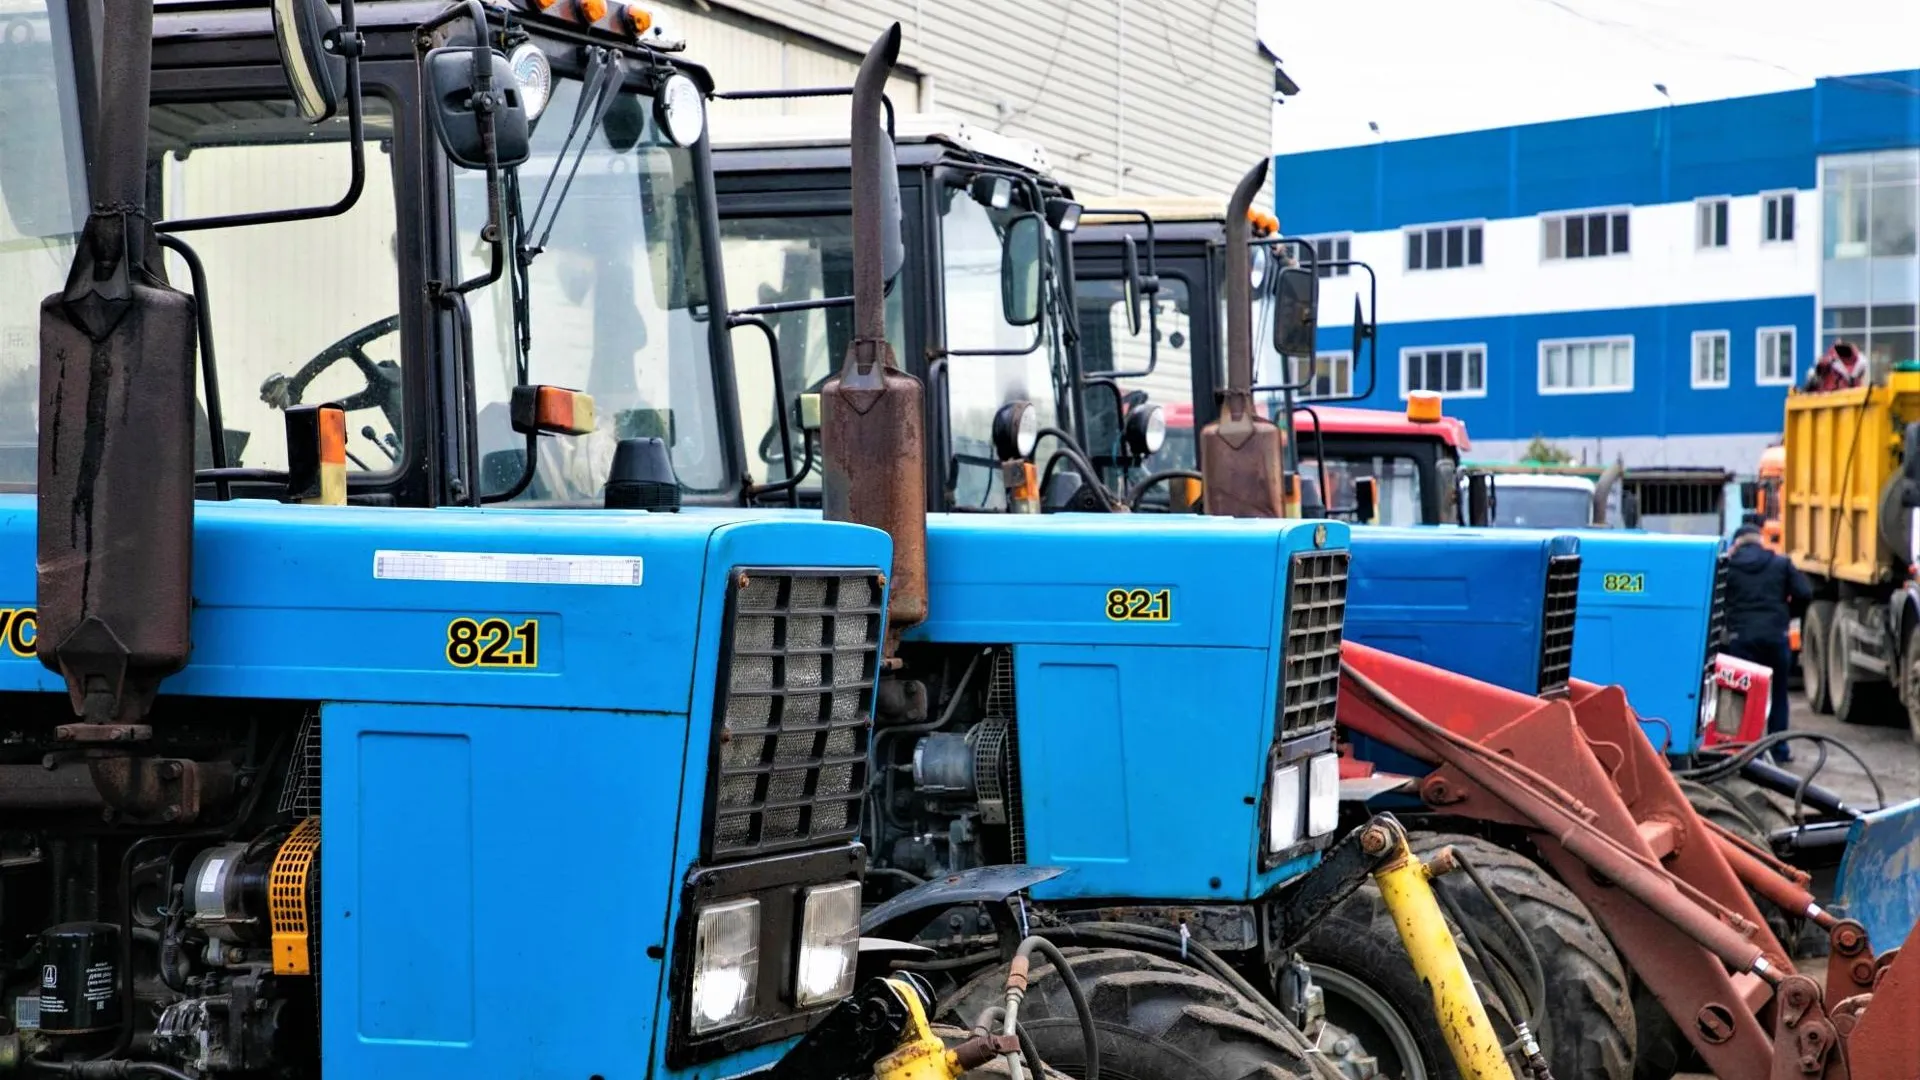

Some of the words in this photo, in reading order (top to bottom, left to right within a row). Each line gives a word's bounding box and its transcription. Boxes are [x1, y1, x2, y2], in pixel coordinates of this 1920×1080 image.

[1604, 572, 1644, 593] 82.1
[1105, 588, 1171, 621] 82.1
[446, 617, 539, 668] 82.1
